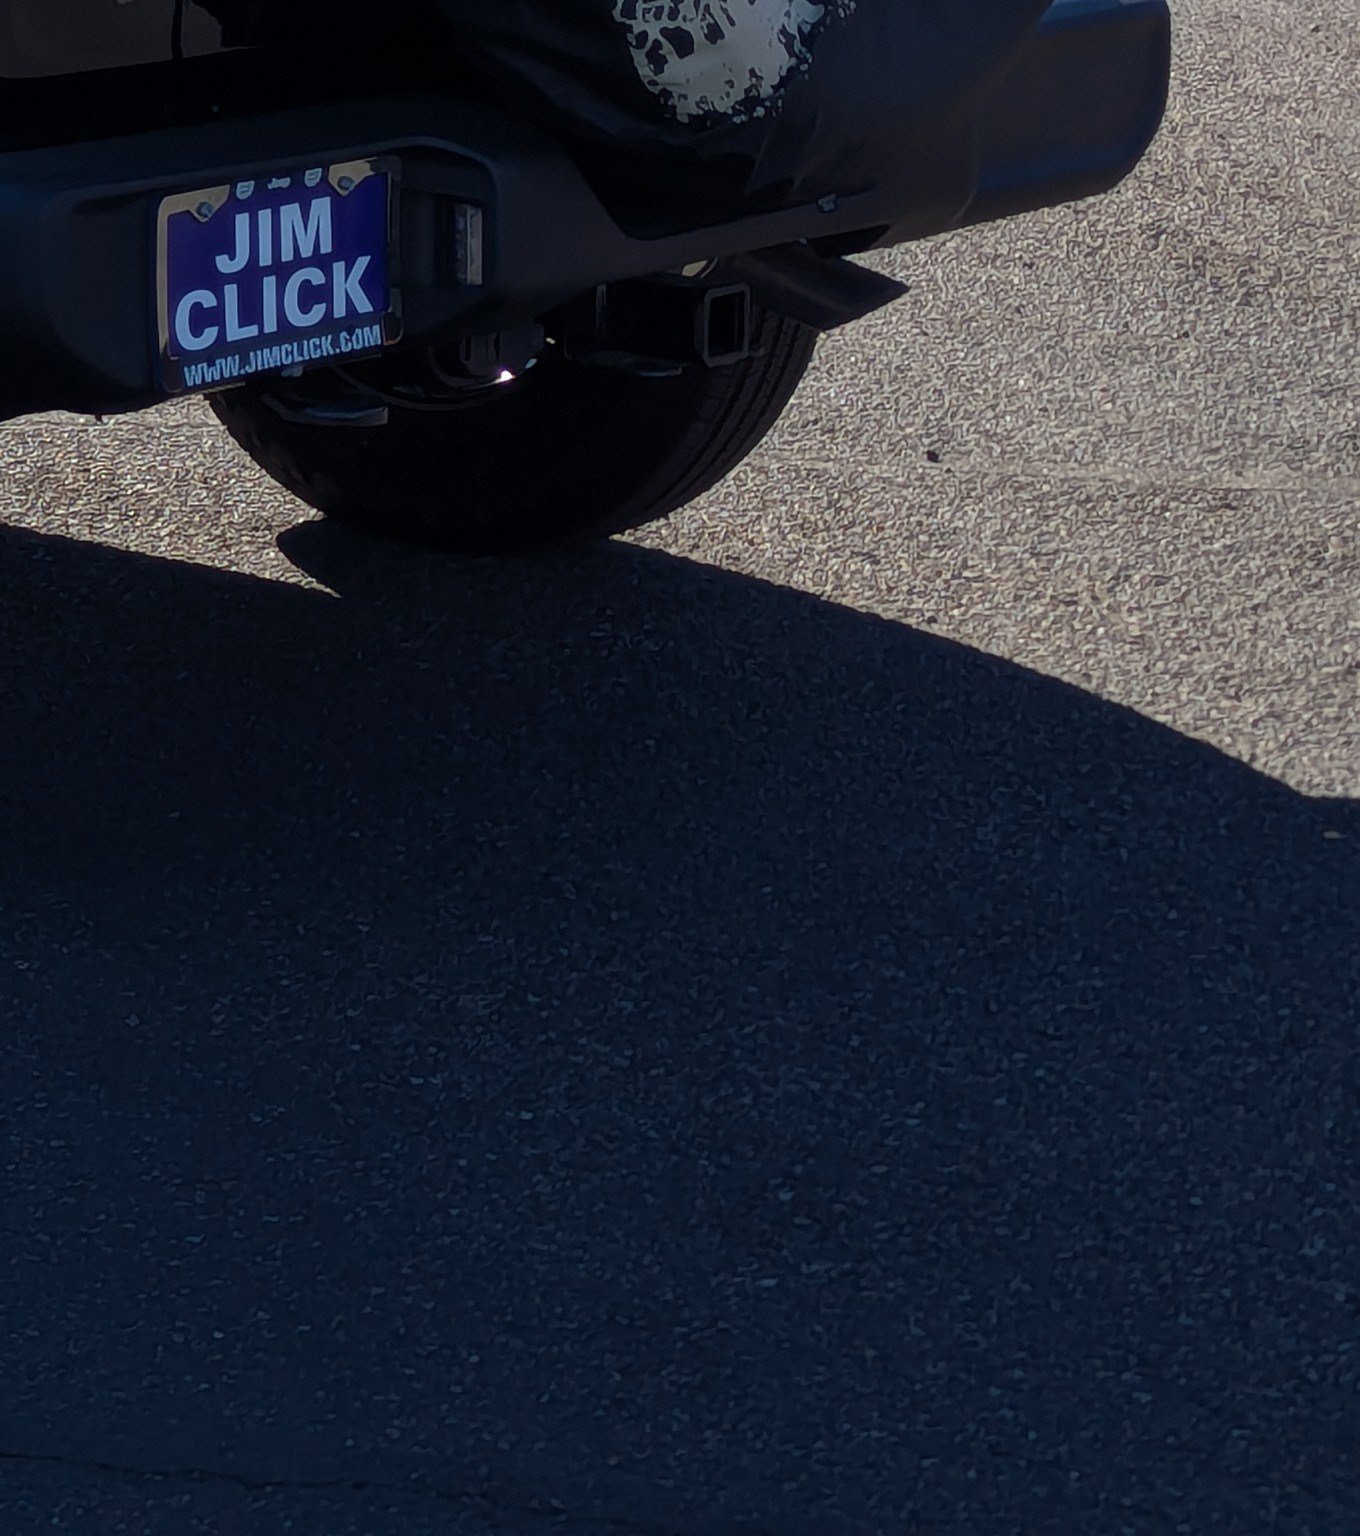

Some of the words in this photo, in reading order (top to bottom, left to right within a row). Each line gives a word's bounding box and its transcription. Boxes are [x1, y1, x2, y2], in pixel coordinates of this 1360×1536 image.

[215, 196, 333, 274] JIM
[174, 255, 374, 352] CLICK
[183, 323, 381, 388] WWW.JIMCLICK.COM
